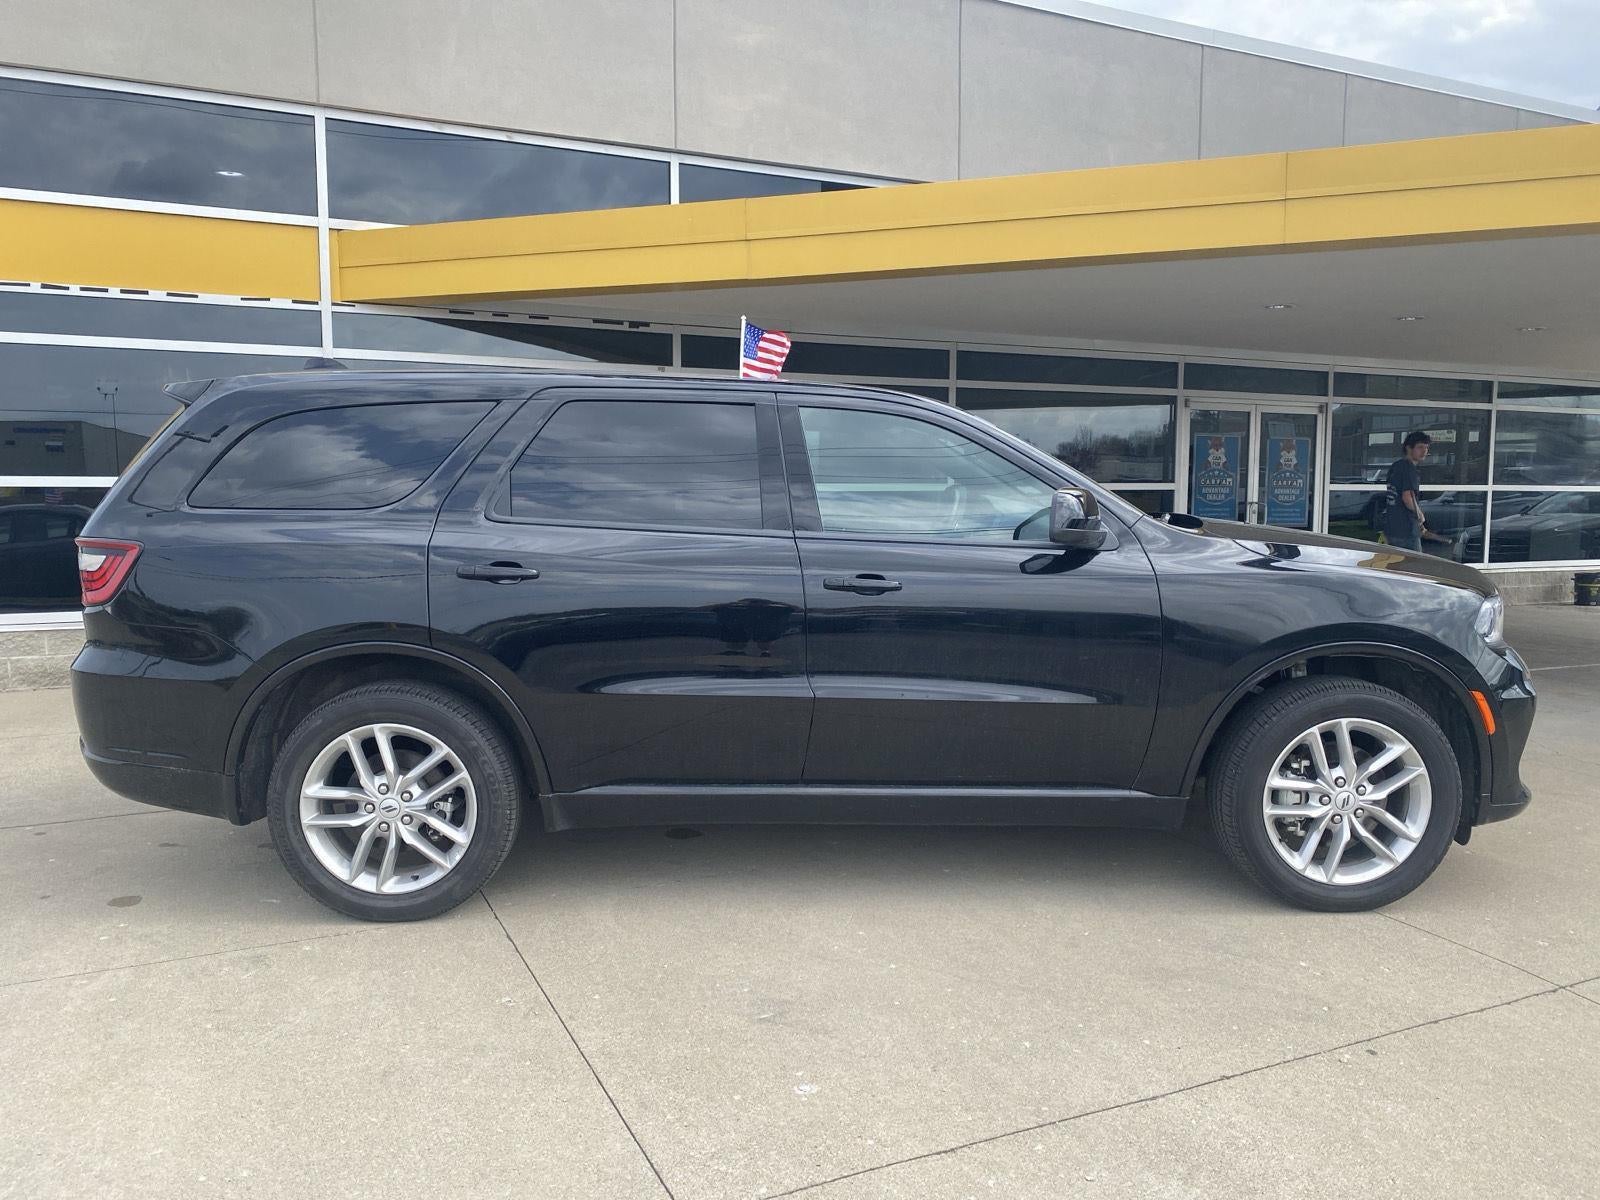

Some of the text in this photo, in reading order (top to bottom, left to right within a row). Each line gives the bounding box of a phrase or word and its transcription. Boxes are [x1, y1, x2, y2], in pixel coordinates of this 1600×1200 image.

[1200, 477, 1232, 487] CARFAX
[1273, 479, 1303, 488] CARFAX
[1206, 493, 1225, 501] DEALER
